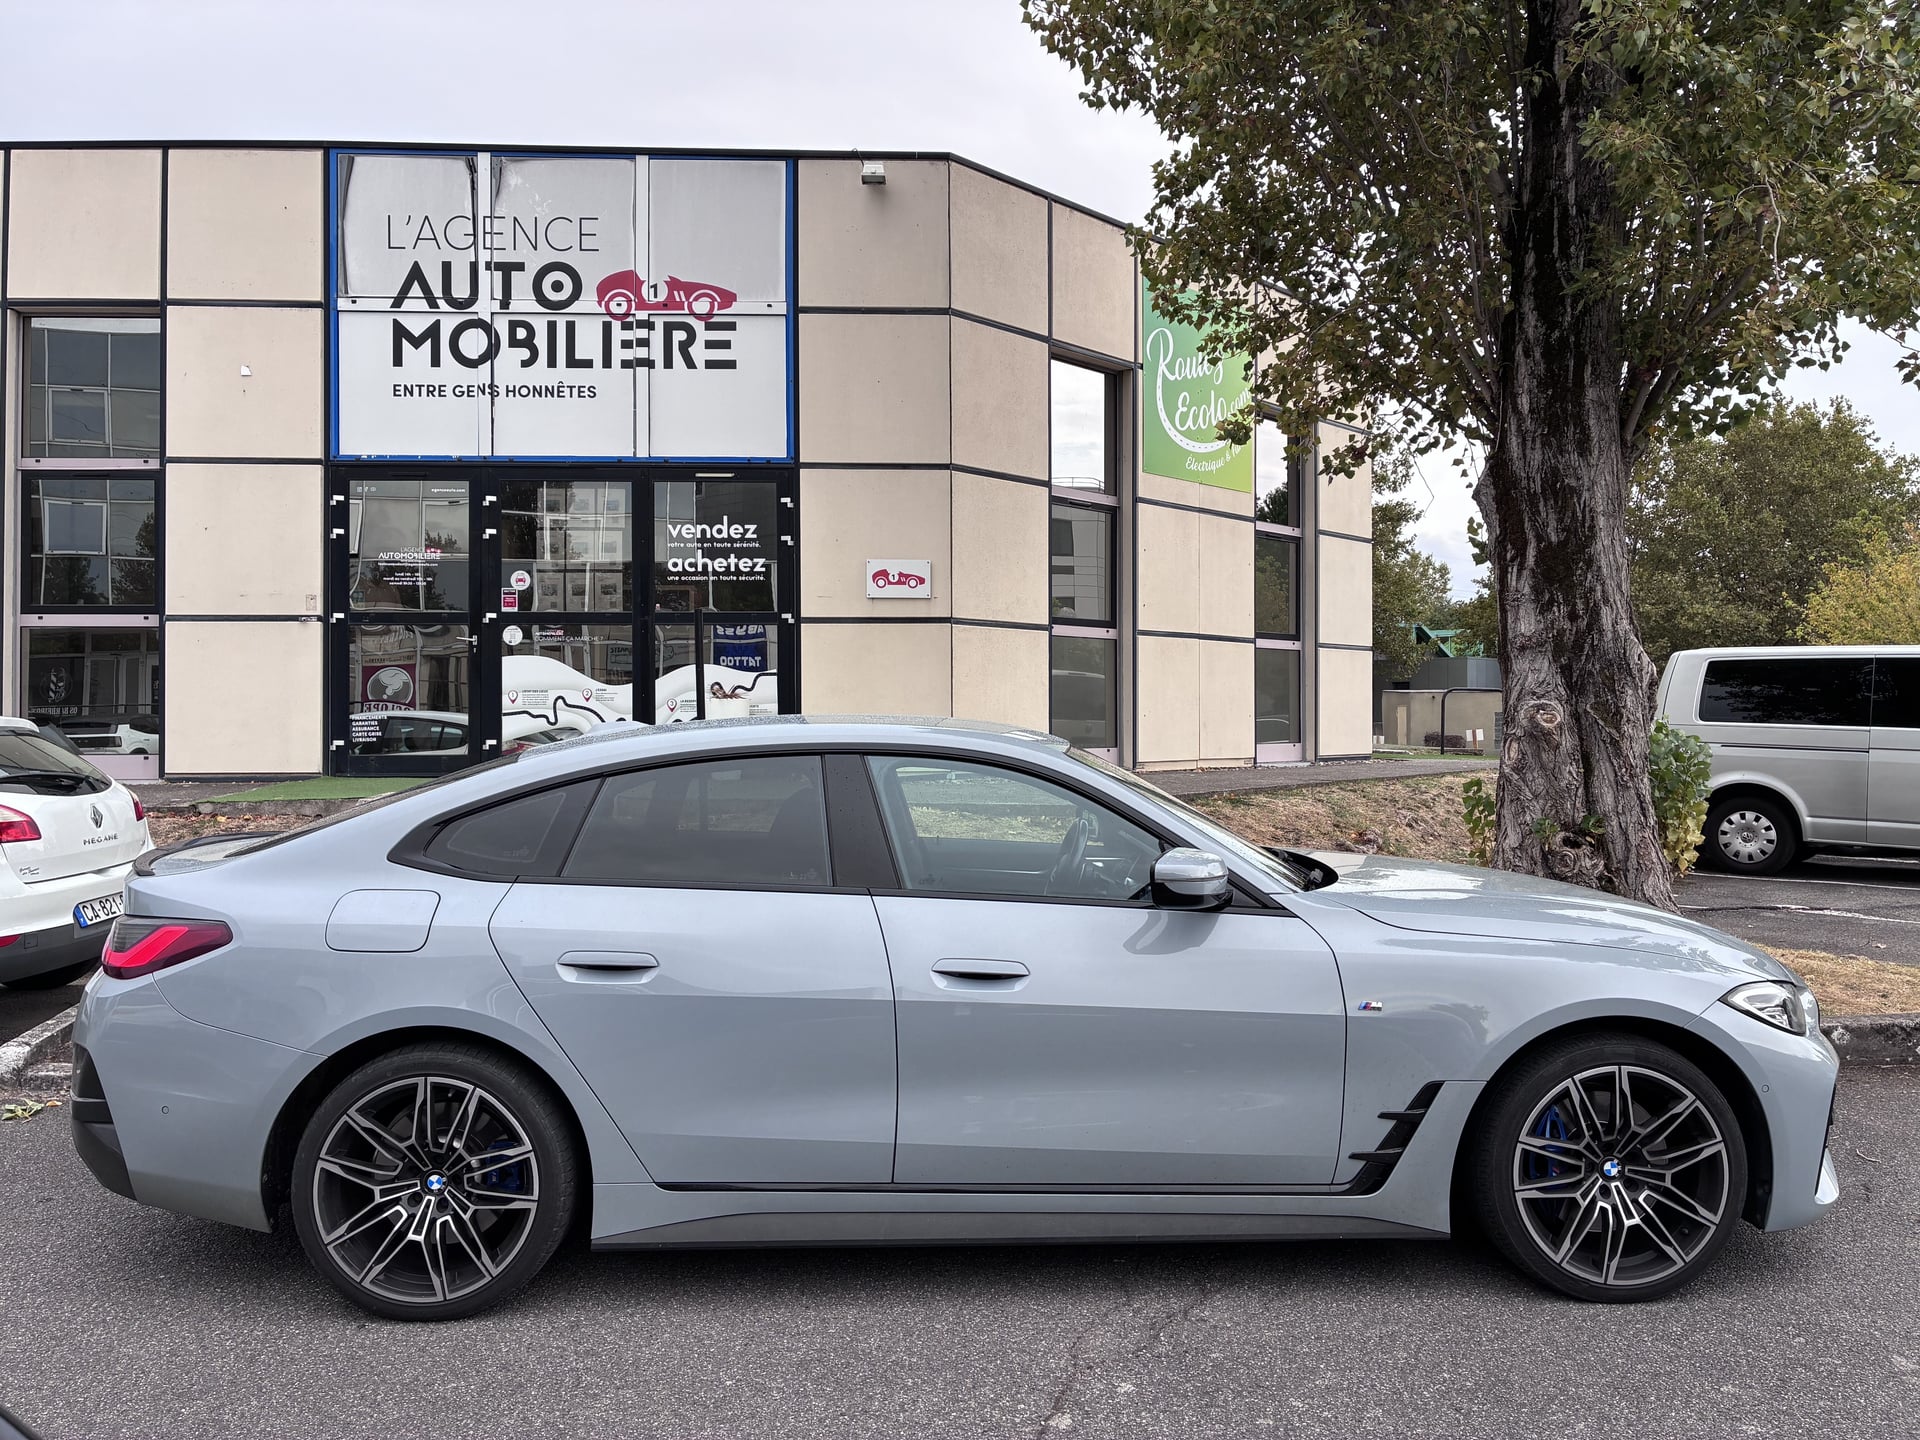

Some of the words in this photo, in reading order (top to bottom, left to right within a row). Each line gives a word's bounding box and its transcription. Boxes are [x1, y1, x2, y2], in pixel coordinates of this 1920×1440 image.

[386, 215, 600, 252] L'AGENCE
[390, 260, 583, 311] AUTO
[648, 282, 659, 299] 1
[392, 318, 737, 370] MOBILIERE
[392, 383, 447, 398] ENTRE
[452, 383, 500, 398] GENS
[505, 380, 597, 399] HONNÊTES
[1185, 454, 1225, 474] Électrique
[667, 515, 757, 539] vendez
[733, 540, 761, 548] sérénité.
[667, 549, 766, 572] achetez
[739, 573, 766, 581] sécurité.
